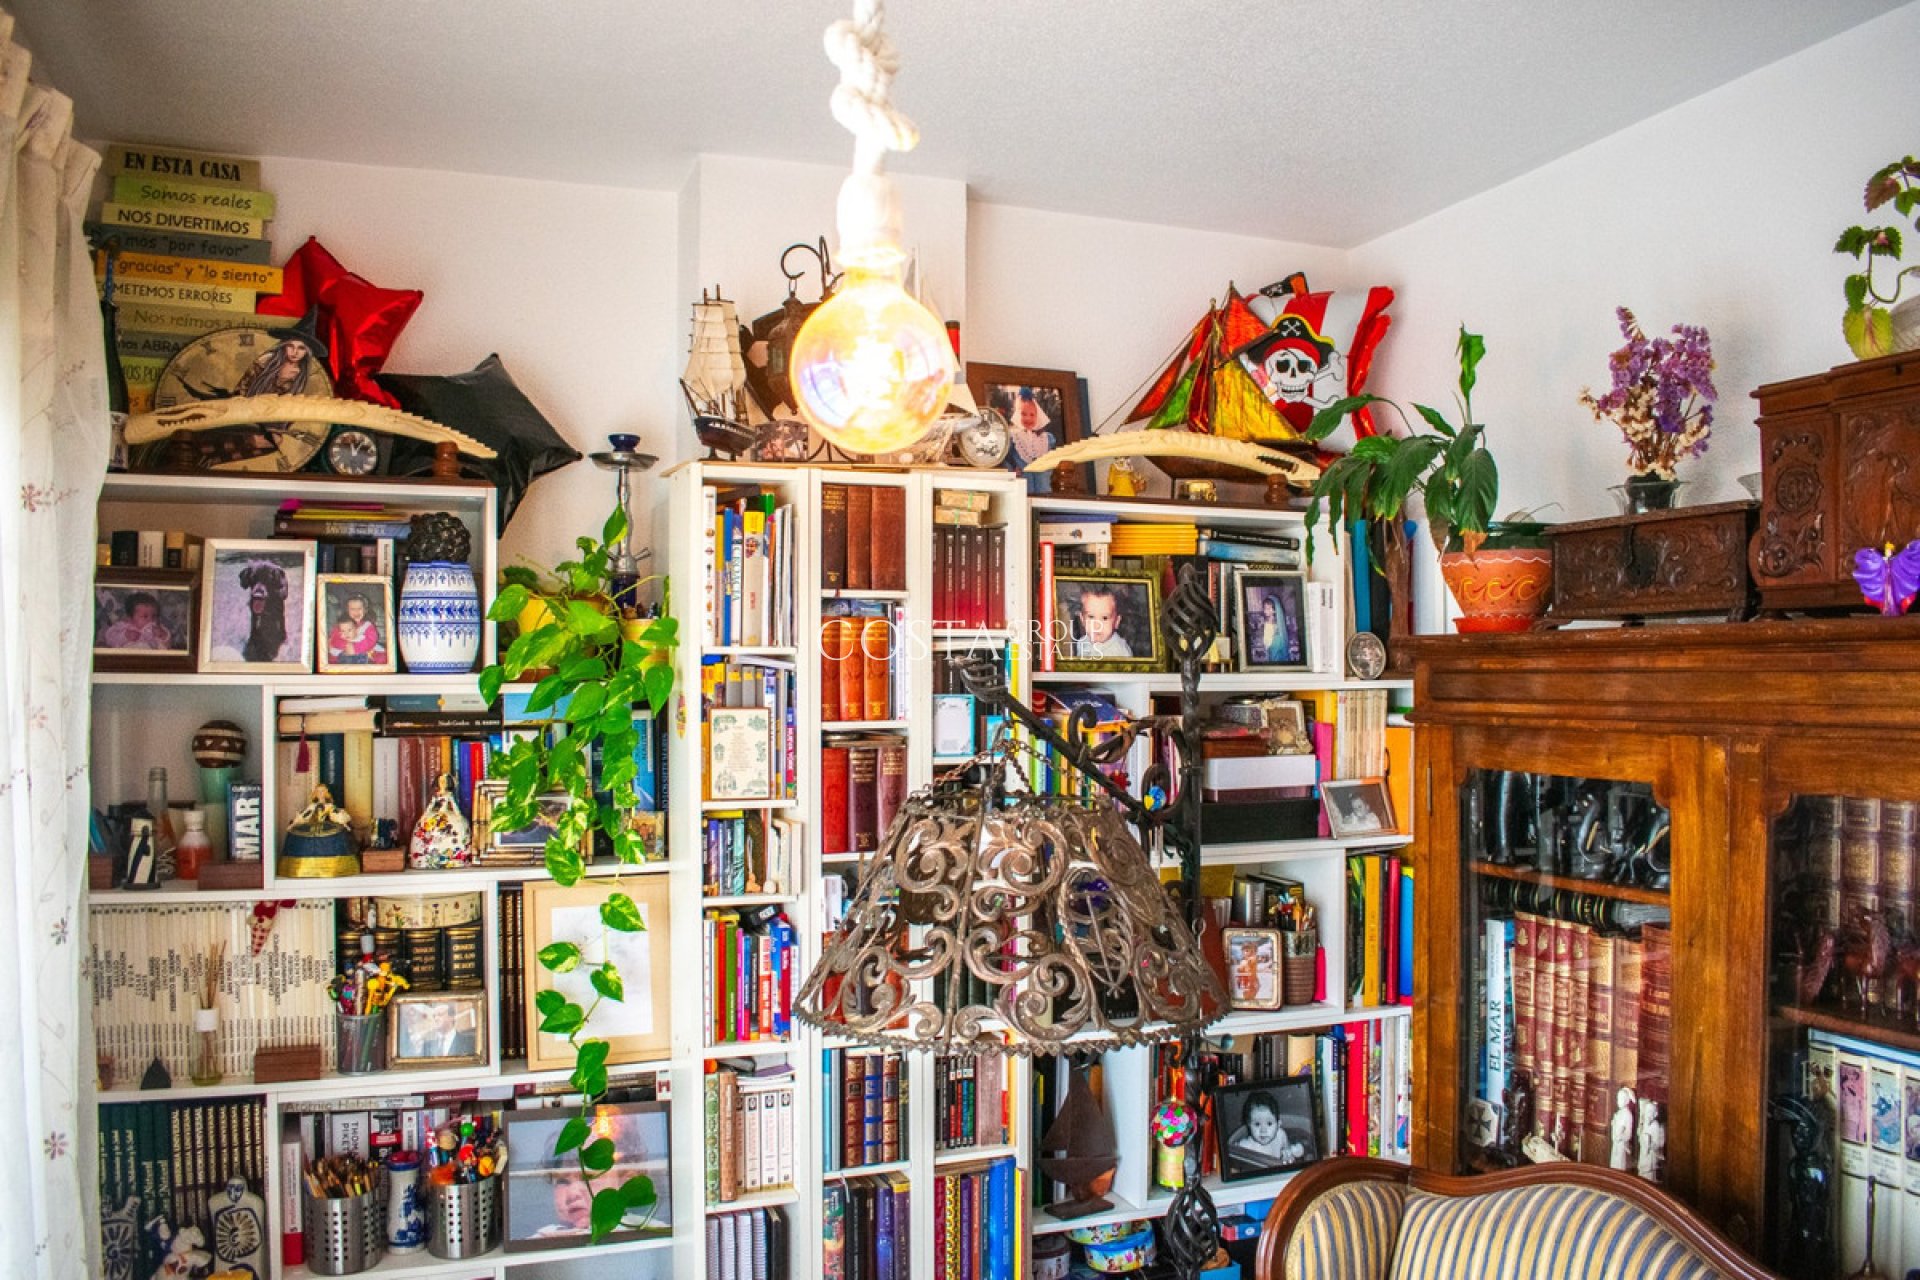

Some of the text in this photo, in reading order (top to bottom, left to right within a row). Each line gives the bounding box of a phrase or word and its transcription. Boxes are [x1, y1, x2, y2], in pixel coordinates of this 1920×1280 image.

[124, 152, 241, 182] EN ESTA CASA
[140, 184, 253, 210] Somos reales
[117, 208, 250, 235] NOS DIVERTIMOS
[184, 267, 194, 280] y
[178, 288, 233, 304] ERRORES
[133, 309, 164, 323] Nos
[234, 797, 260, 860] MAR
[1489, 1000, 1501, 1071] EL MAR
